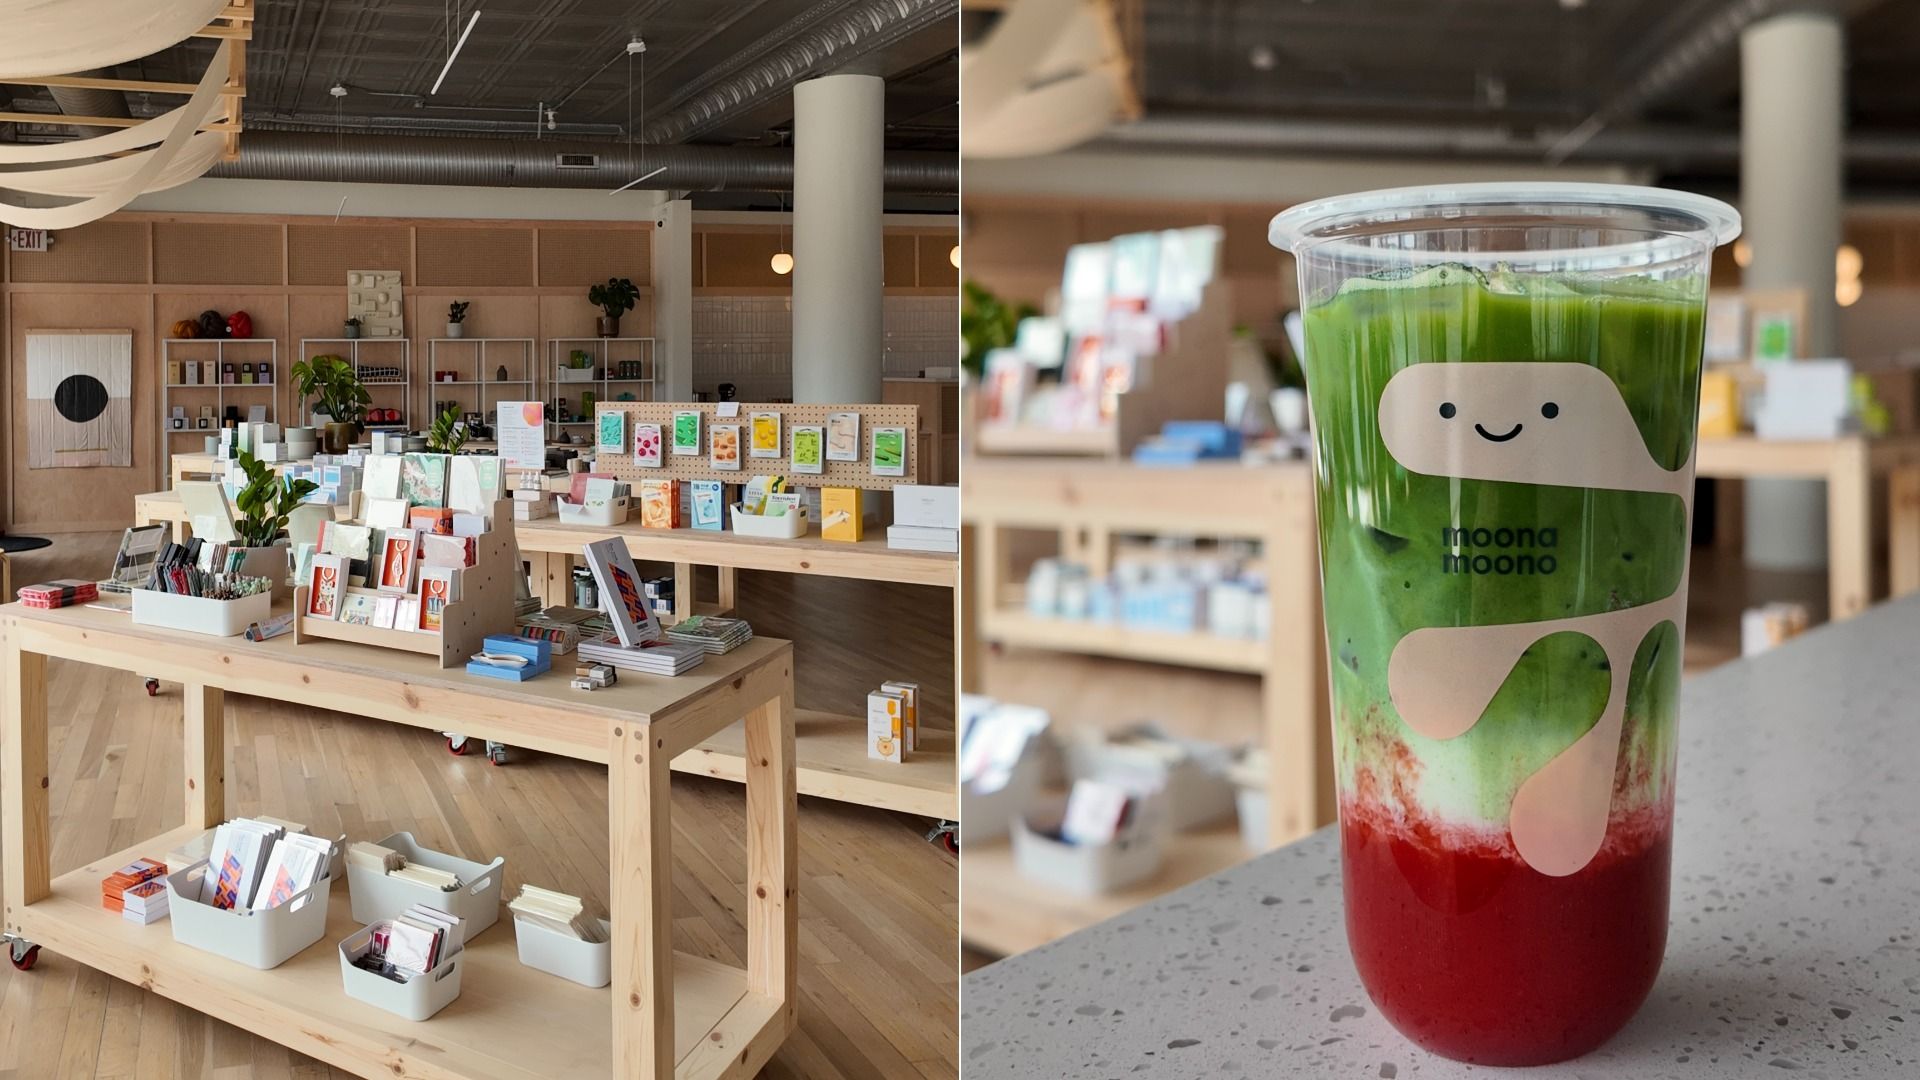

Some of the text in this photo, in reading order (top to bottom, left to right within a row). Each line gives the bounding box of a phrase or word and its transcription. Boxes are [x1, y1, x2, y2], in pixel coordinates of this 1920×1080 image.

[18, 230, 42, 249] EXIT
[1442, 527, 1558, 548] moona
[1442, 553, 1557, 575] moono
